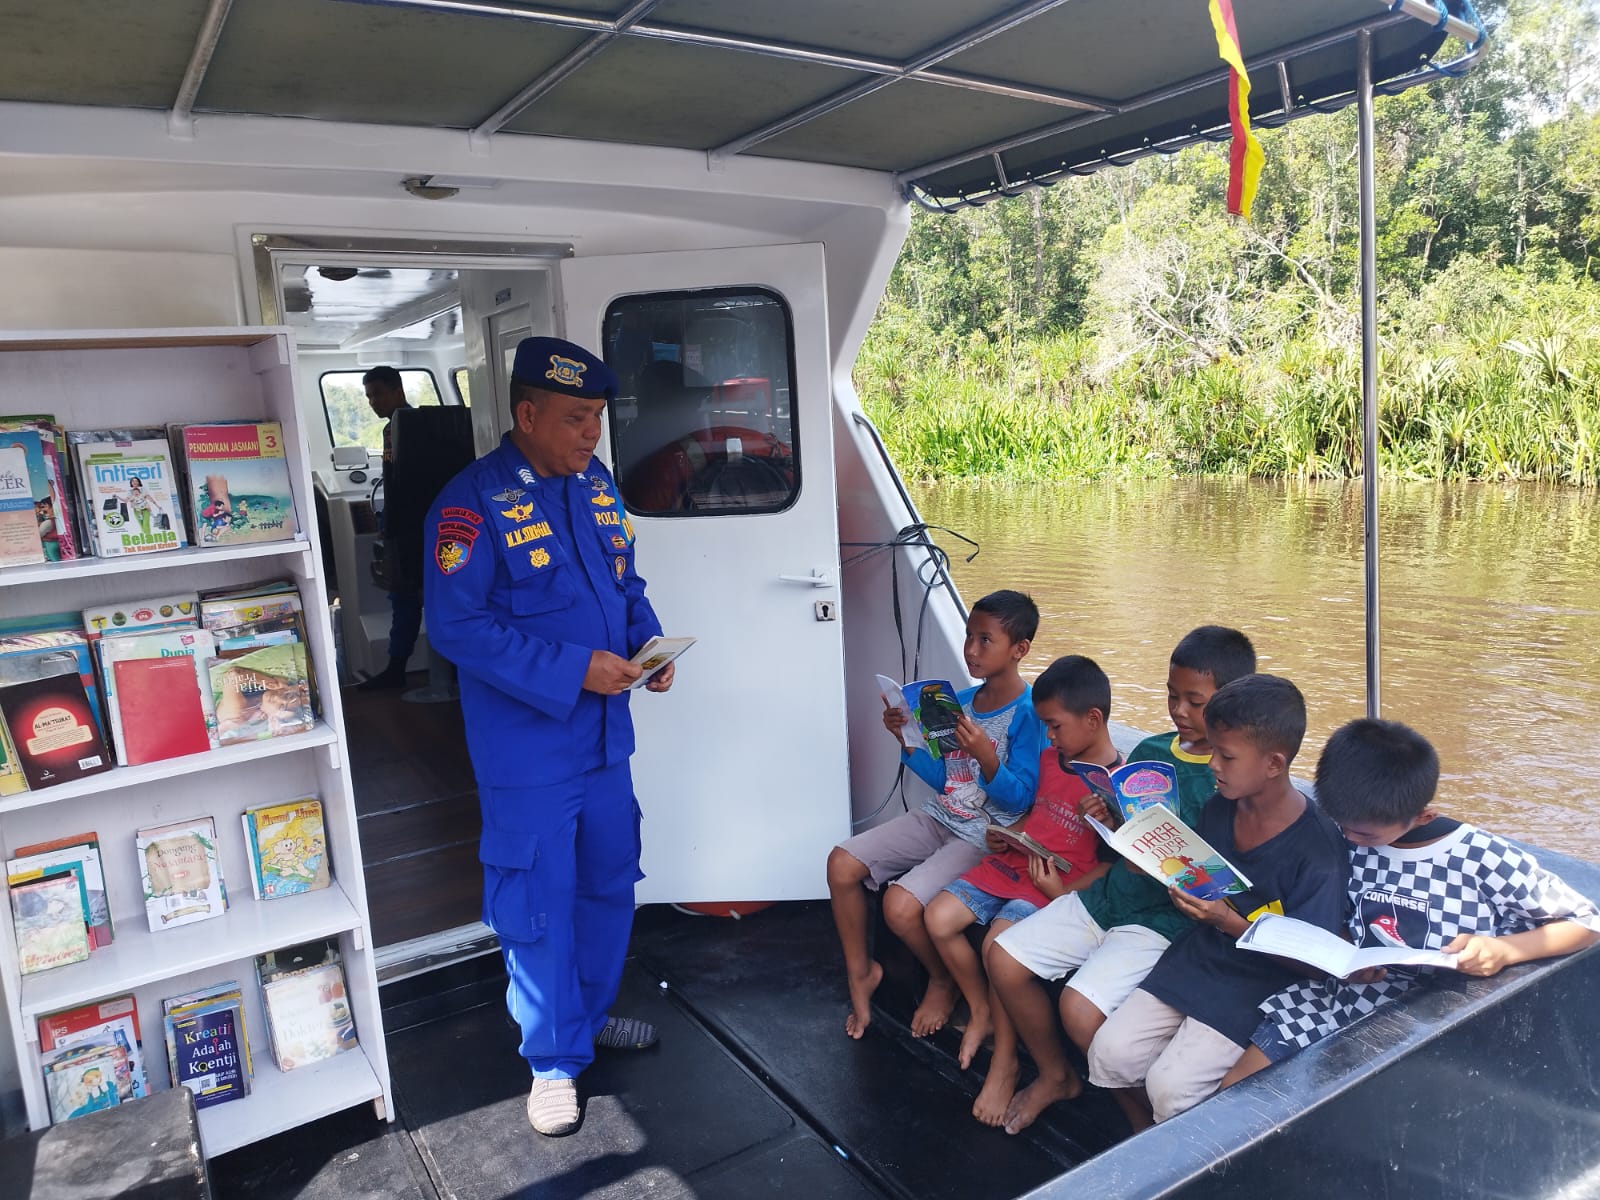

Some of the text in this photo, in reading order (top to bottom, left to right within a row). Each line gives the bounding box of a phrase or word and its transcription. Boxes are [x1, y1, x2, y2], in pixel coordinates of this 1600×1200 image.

[188, 440, 259, 453] PENDIDIKAN JASMANI
[265, 435, 277, 448] 3
[121, 531, 177, 547] Belanja
[236, 680, 266, 693] Pijat
[1131, 821, 1182, 855] NAGA
[1363, 890, 1427, 913] CONVERSE
[52, 1026, 68, 1038] IPS
[184, 1023, 232, 1045] Kreatif
[192, 1038, 232, 1058] Adalah
[188, 1052, 237, 1074] Koentji
